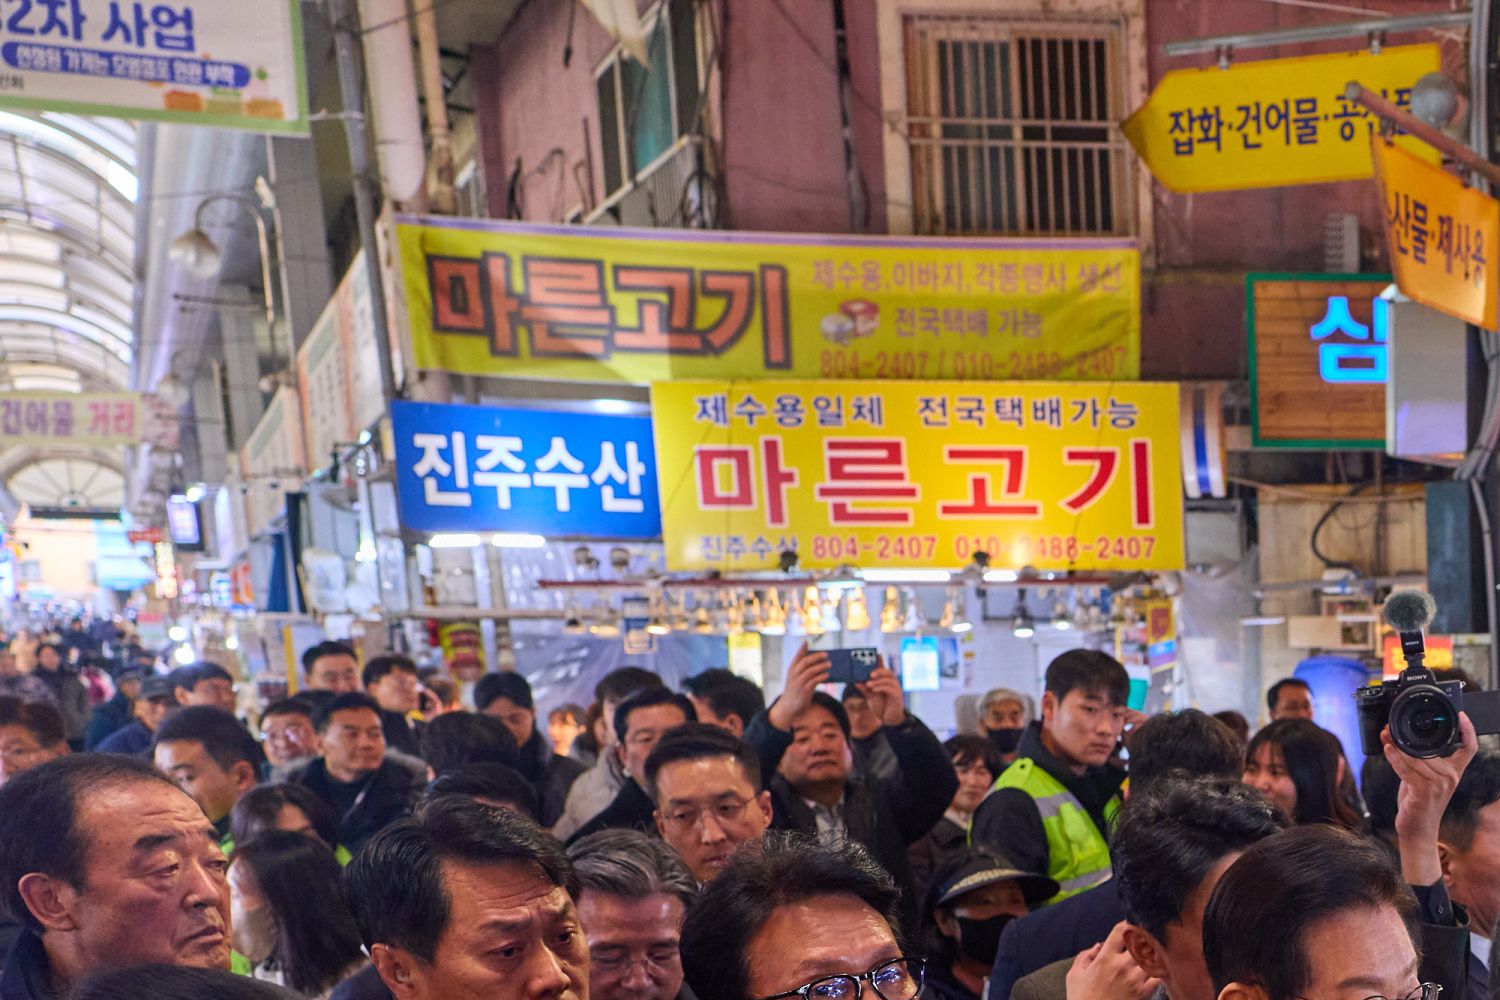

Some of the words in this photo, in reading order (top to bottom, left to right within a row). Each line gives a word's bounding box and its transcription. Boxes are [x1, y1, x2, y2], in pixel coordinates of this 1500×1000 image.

[101, 1, 195, 51] 사업
[1386, 190, 1486, 289] 산물·제사용
[425, 251, 793, 371] 마른고기
[896, 307, 989, 338] 전국택배
[997, 309, 1043, 339] 가능
[820, 349, 929, 379] 804-2407
[694, 394, 884, 428] 제수용일체
[917, 394, 1140, 428] 전국택배가능
[410, 430, 646, 514] 진주수산
[694, 434, 1155, 528] 마른고기
[812, 535, 937, 561] 804-2407
[954, 535, 1156, 561] 010-2488-2407
[1406, 674, 1428, 682] SONY
